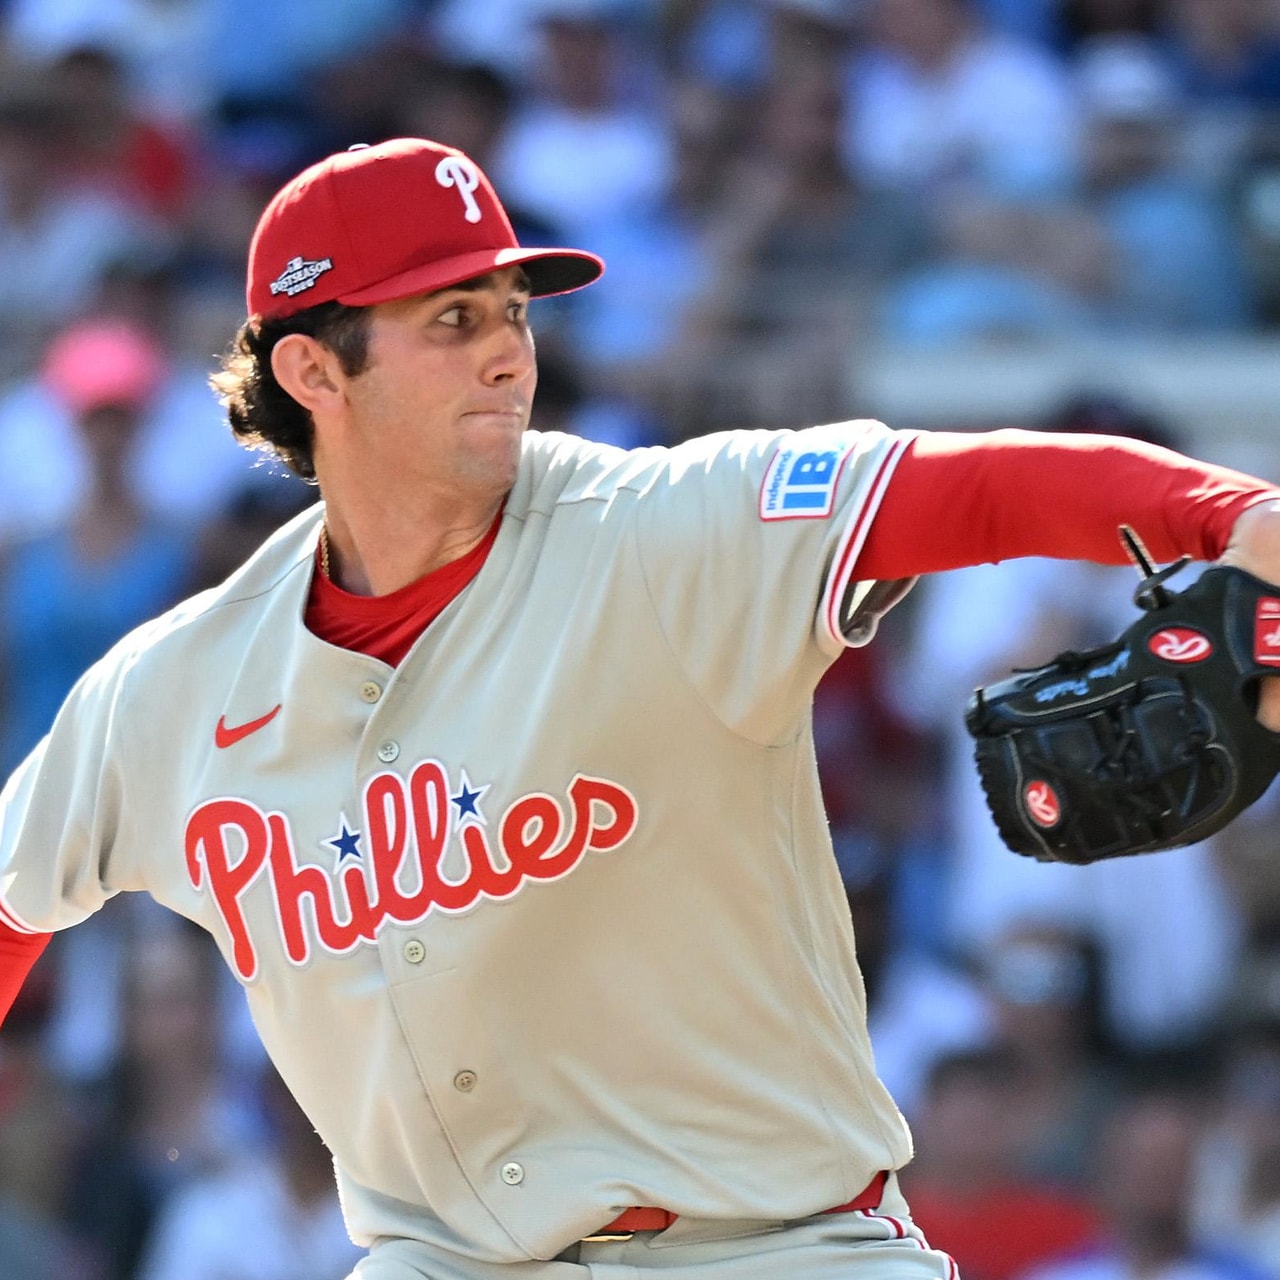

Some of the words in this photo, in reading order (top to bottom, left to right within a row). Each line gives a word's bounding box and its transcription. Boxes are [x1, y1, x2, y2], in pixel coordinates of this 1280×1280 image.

[434, 156, 482, 224] P
[270, 258, 332, 295] POSTSEASON
[766, 450, 793, 510] Independ
[782, 452, 838, 509] IB
[1157, 630, 1210, 661] R
[184, 758, 639, 981] Phillies
